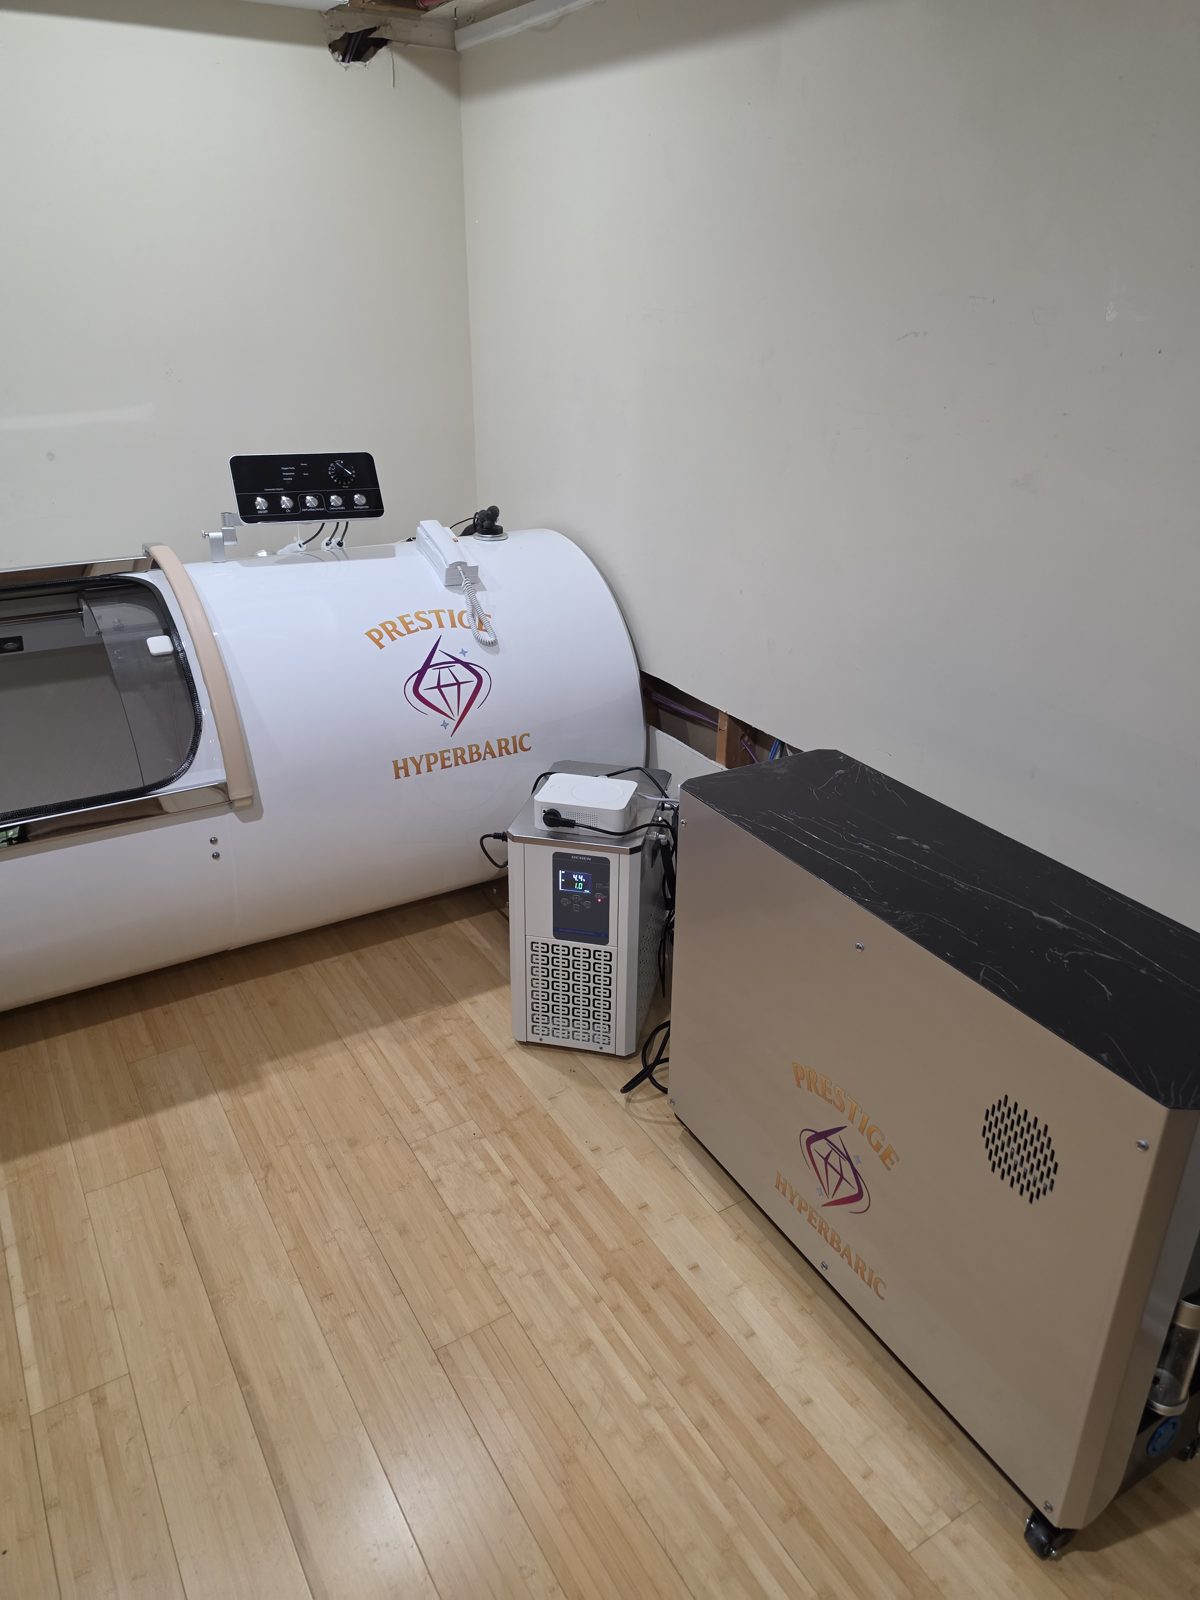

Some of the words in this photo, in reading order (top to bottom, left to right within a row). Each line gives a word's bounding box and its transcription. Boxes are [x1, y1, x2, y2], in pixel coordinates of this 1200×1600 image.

[392, 733, 532, 780] HYPERBARIC
[575, 882, 583, 890] 1.0
[792, 1062, 900, 1171] PRESTIGE
[775, 1169, 887, 1300] HYPERBARIC
